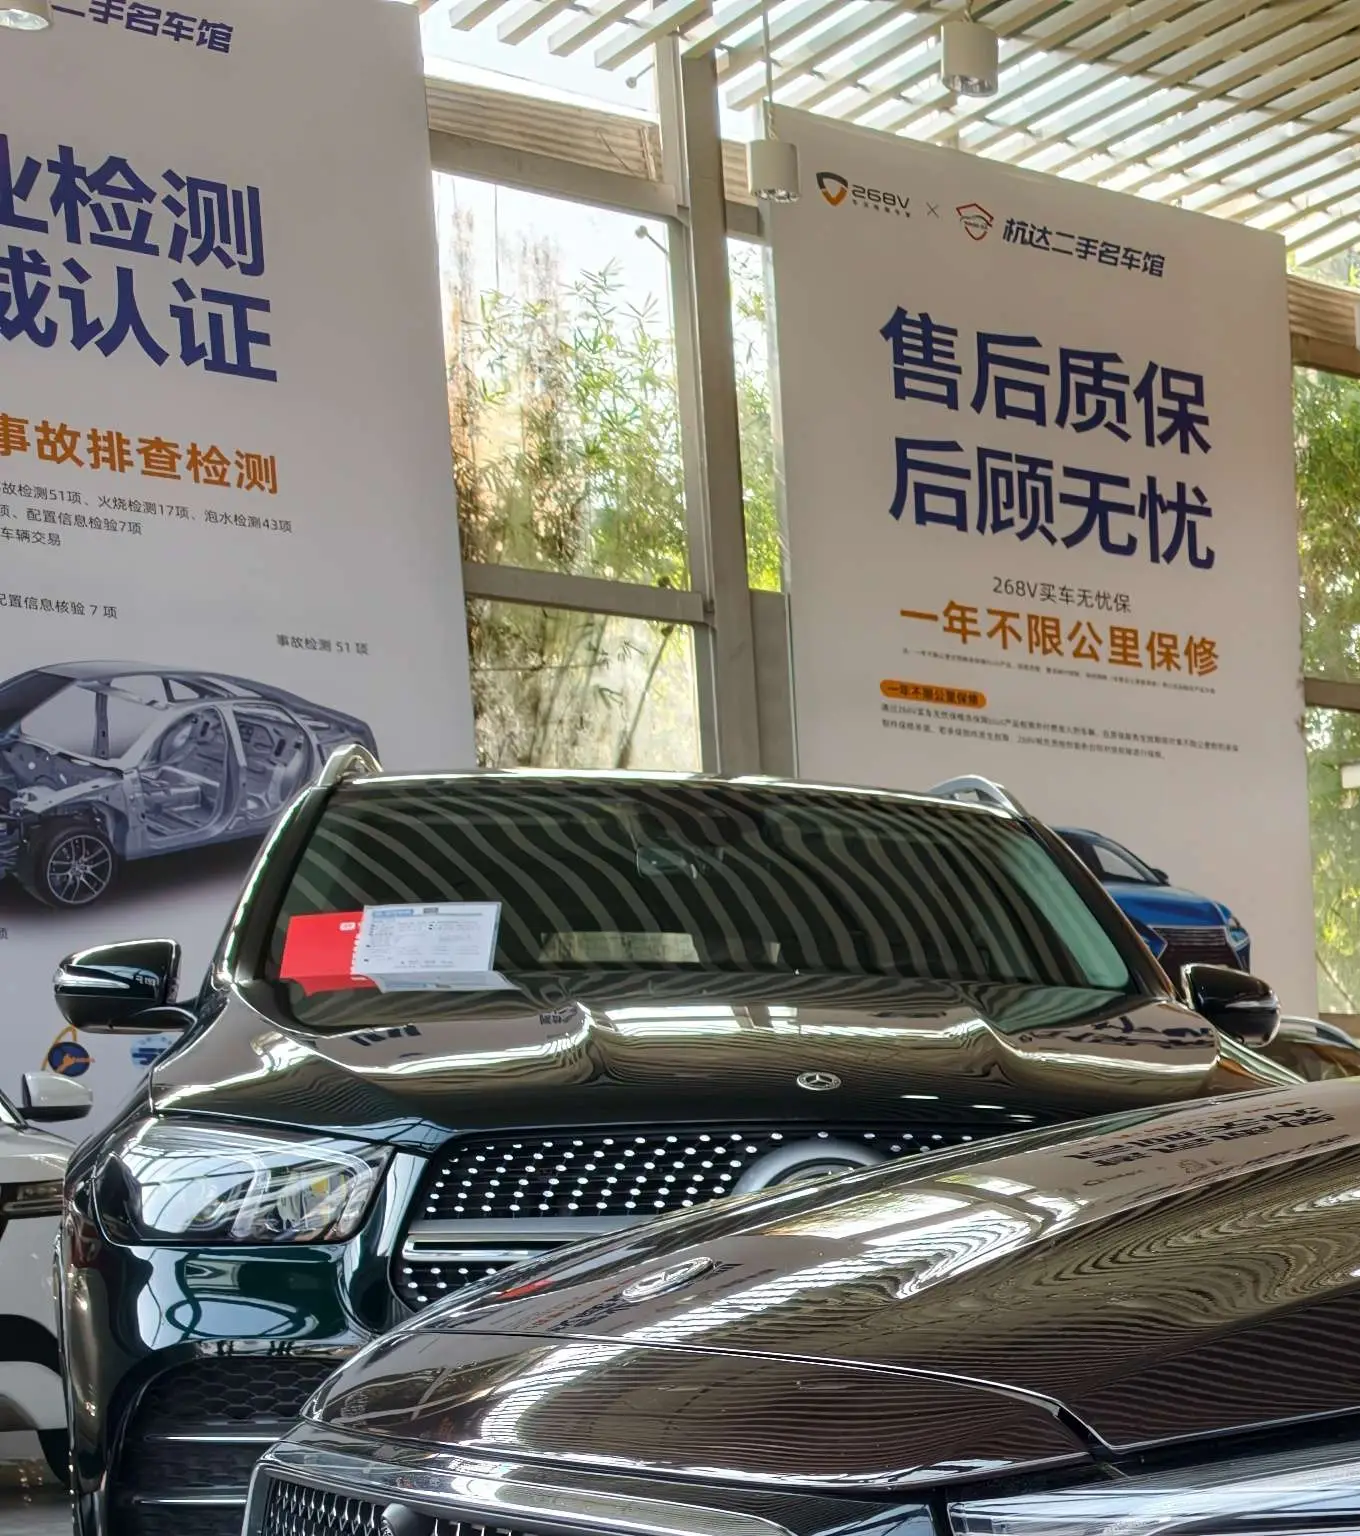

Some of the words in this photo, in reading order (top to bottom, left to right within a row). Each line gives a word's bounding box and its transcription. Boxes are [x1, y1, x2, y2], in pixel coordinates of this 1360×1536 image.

[851, 184, 910, 209] 268V
[1002, 218, 1166, 277] 杭达二手名车馆
[880, 306, 1212, 454] 售后质保
[0, 413, 279, 495] 事故排查检测
[889, 437, 1215, 569] 后顾无忧
[992, 576, 1132, 613] 268V买车无忧保
[900, 600, 1219, 677] 一年不限公里保修
